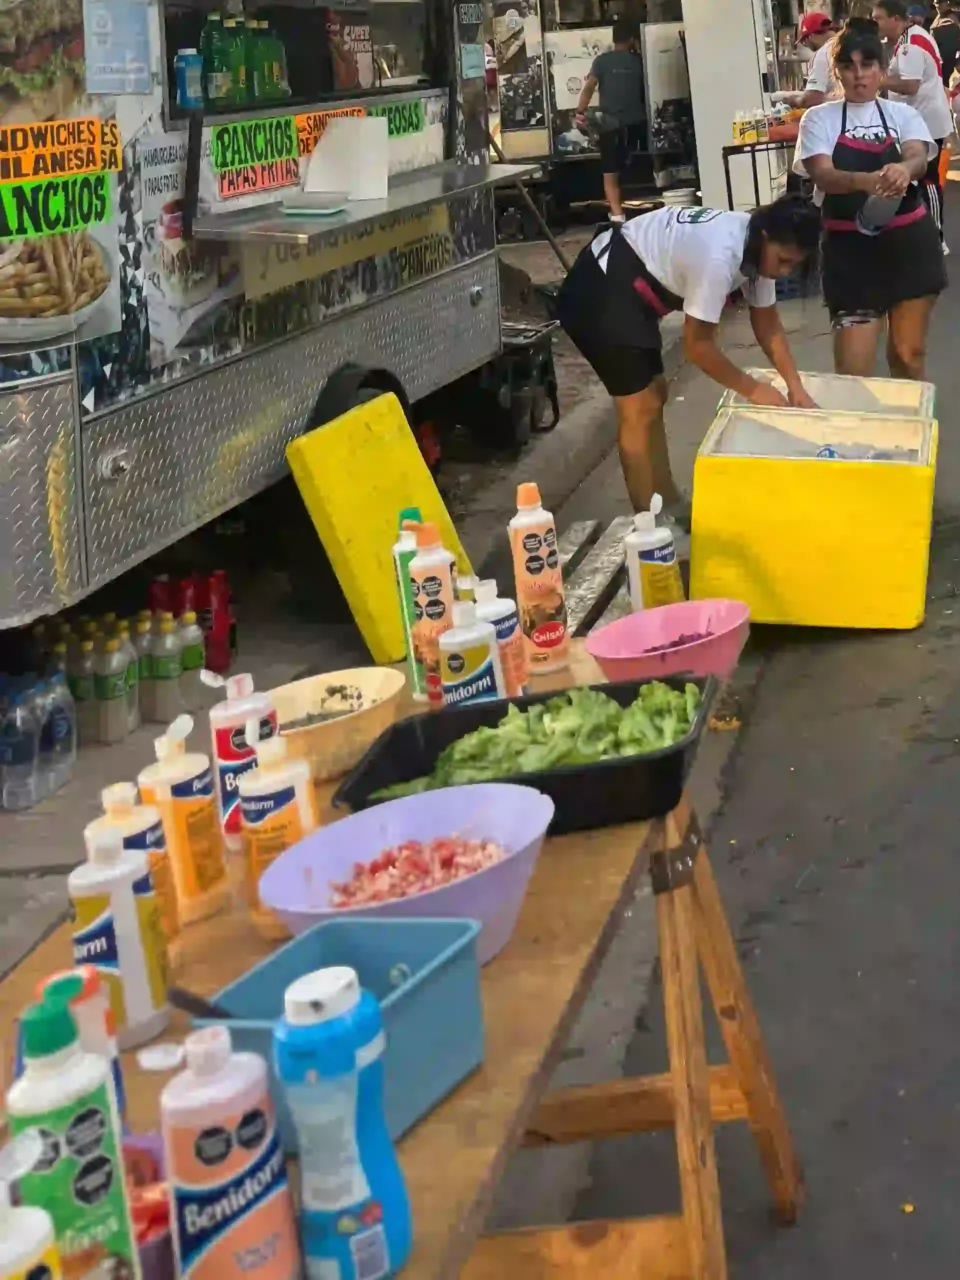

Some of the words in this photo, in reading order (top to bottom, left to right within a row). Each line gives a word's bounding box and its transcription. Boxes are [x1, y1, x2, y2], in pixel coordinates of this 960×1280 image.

[217, 119, 293, 168] PANCHOS
[220, 163, 257, 193] PAPAS
[262, 157, 299, 186] FRITAS
[401, 235, 452, 280] PANCHOS
